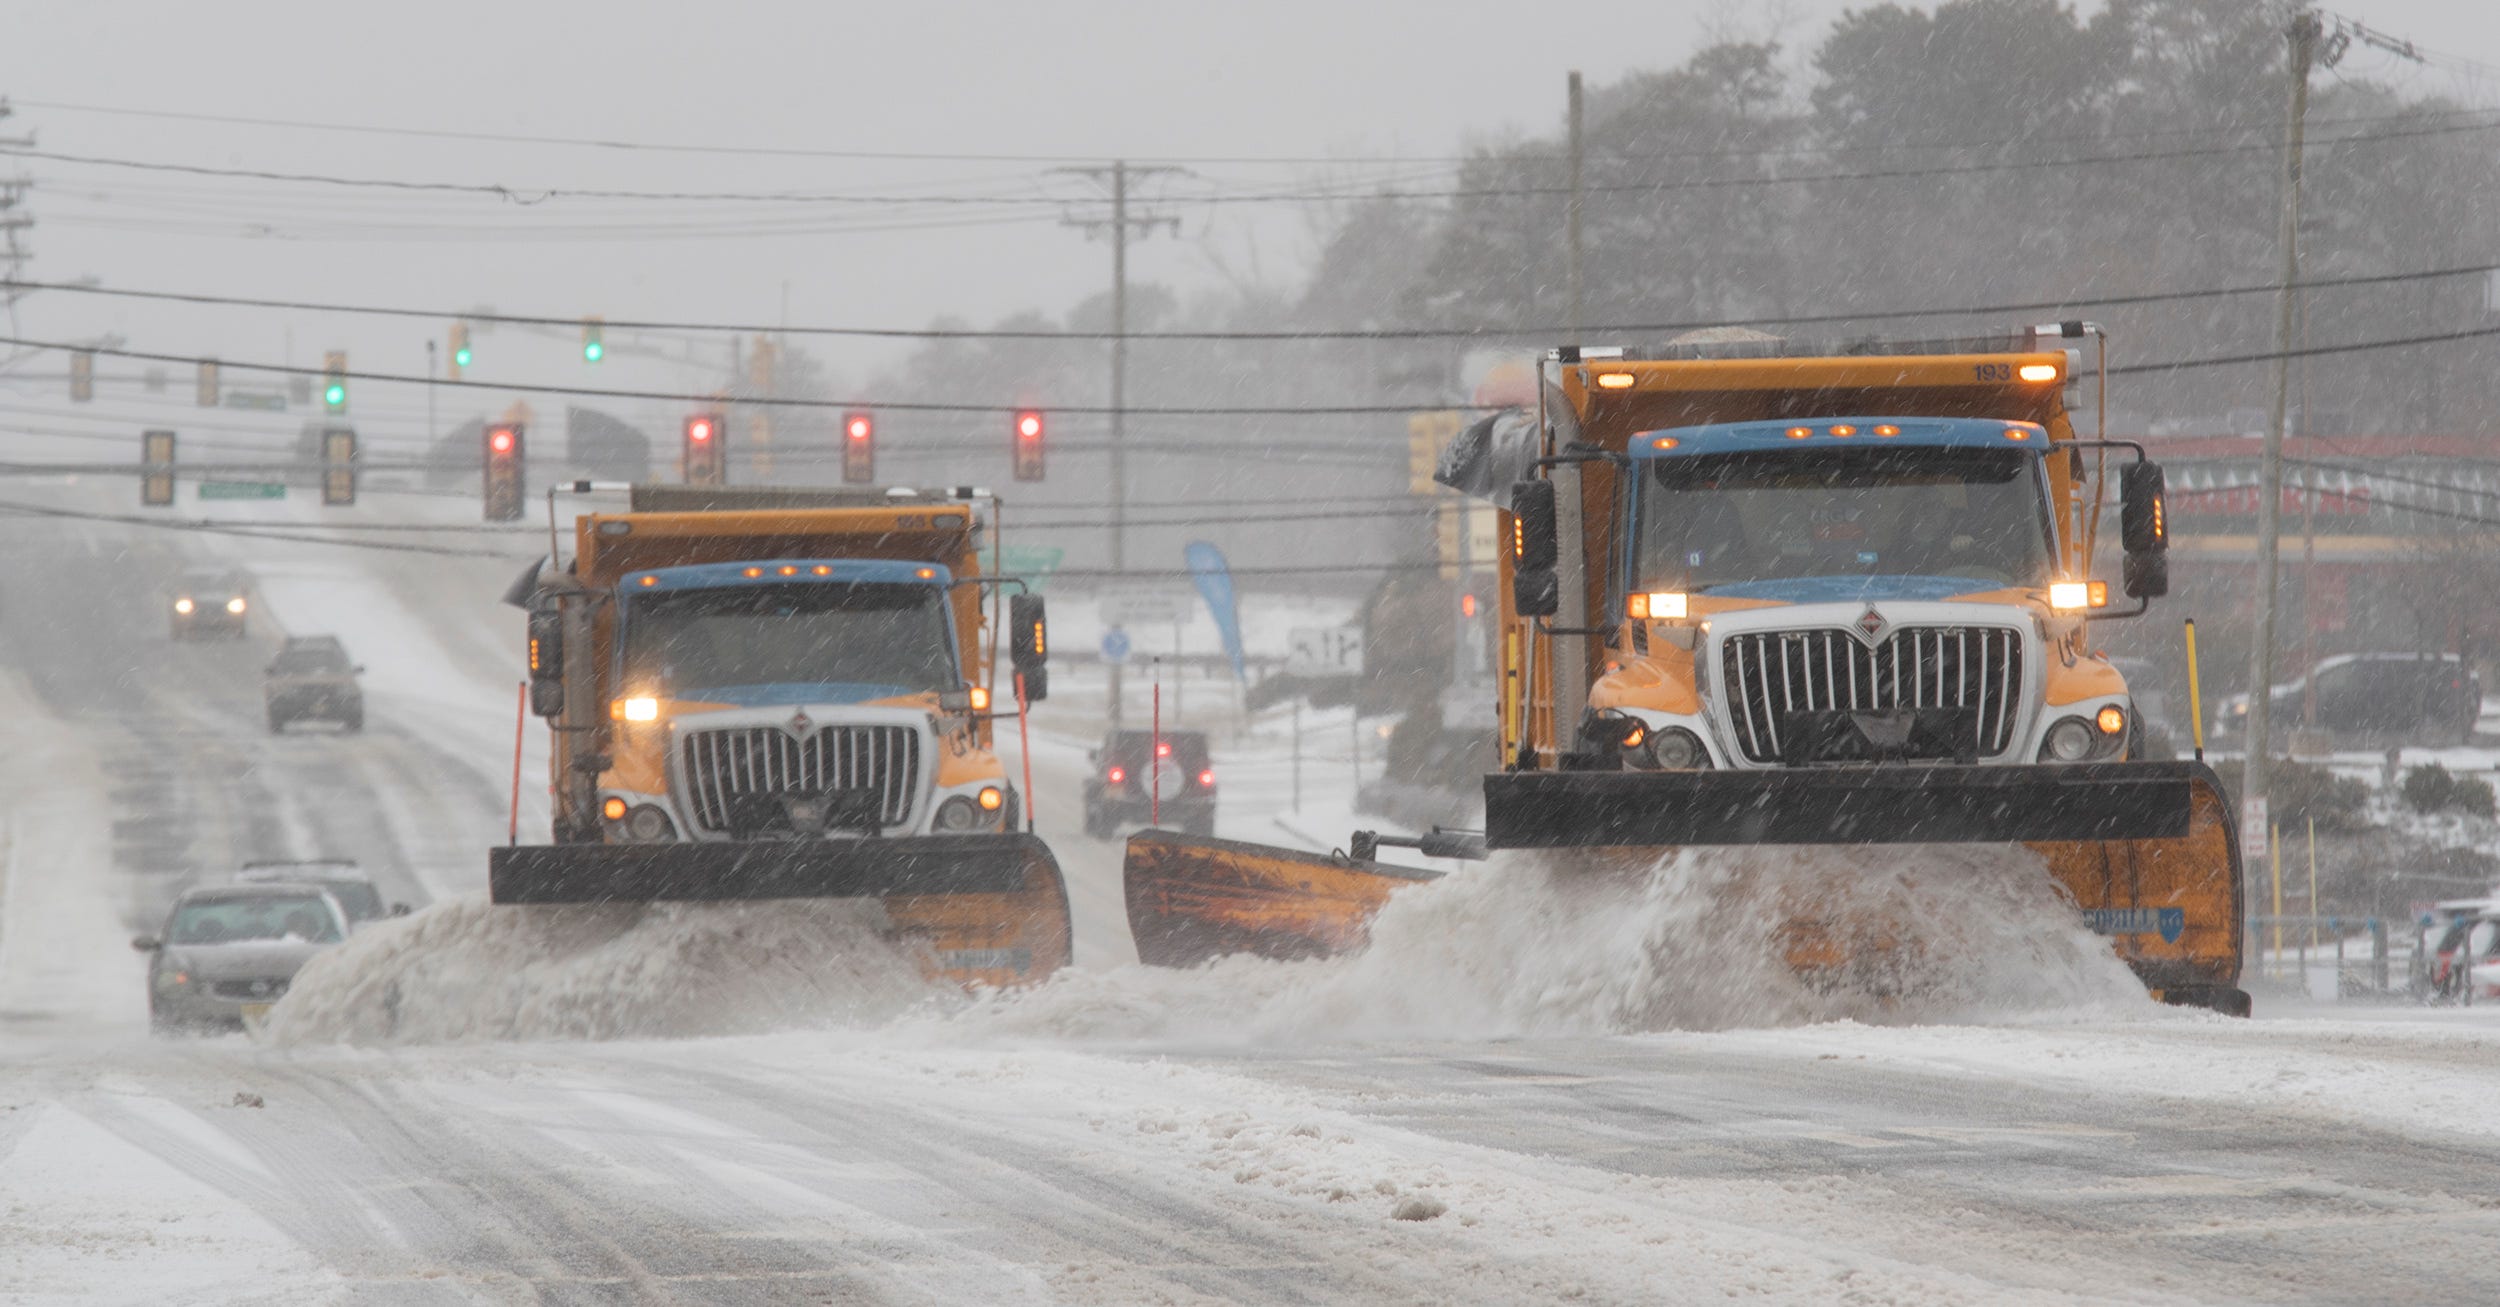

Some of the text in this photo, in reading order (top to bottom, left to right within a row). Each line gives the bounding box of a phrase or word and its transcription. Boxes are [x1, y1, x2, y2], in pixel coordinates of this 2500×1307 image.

[1975, 364, 2011, 381] 193
[2164, 486, 2370, 514] RGER KNG
